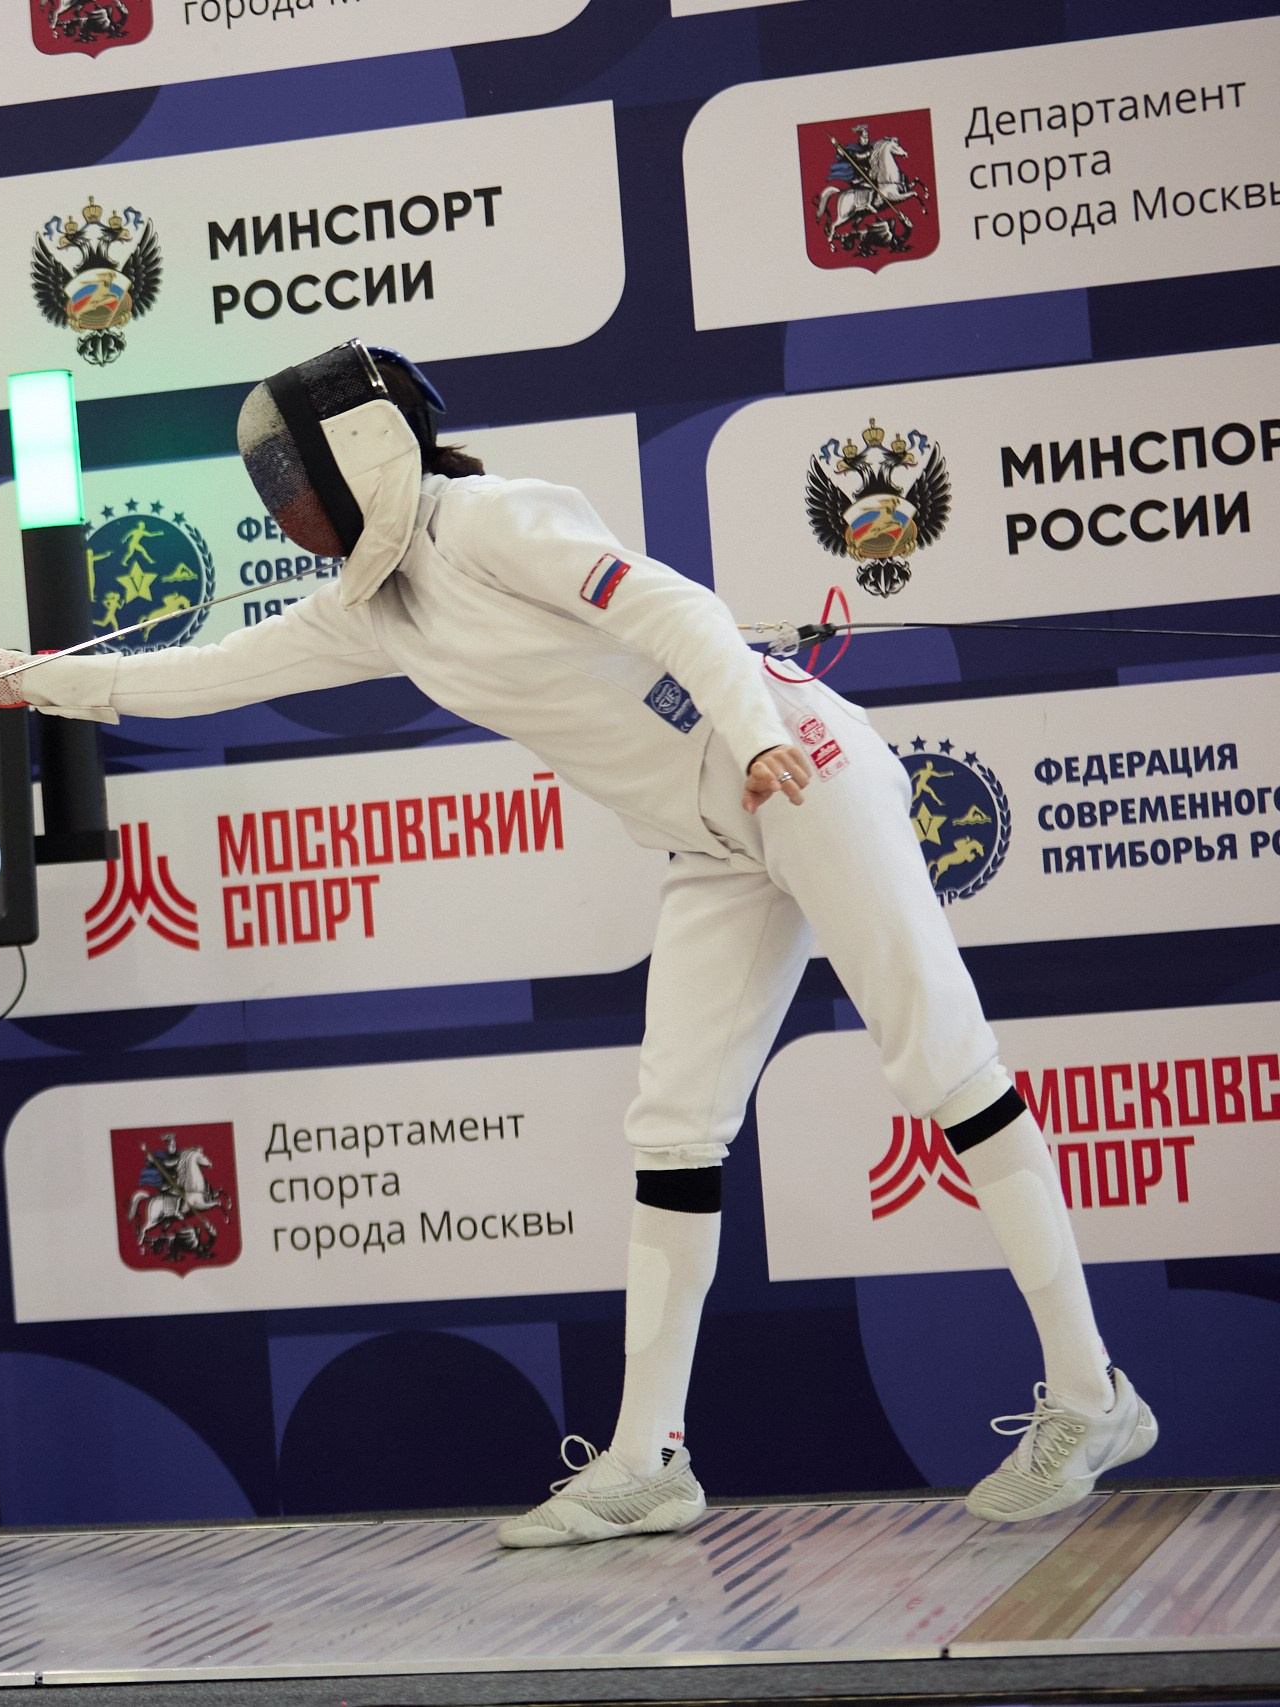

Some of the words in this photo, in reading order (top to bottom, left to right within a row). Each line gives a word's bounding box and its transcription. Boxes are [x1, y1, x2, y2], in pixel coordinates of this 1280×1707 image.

[965, 81, 1247, 148] Департамент
[969, 149, 1111, 192] спорта
[207, 185, 502, 260] МИНСПОРТ
[973, 199, 1117, 245] города
[212, 260, 435, 325] РОССИИ
[1005, 490, 1251, 555] РОССИИ
[1034, 742, 1239, 787] ФЕДЕРАЦИЯ
[218, 772, 565, 878] МОСКОВСКИЙ
[1041, 832, 1239, 875] ПЯТИБОРЬЯ
[223, 874, 381, 950] СПОРТ
[1014, 1053, 1280, 1136] МОСКОВС
[264, 1109, 525, 1163] Департамент
[268, 1166, 401, 1210] спорта
[1047, 1135, 1195, 1211] ПОРТ
[273, 1217, 406, 1260] города
[419, 1209, 576, 1246] Москвы
